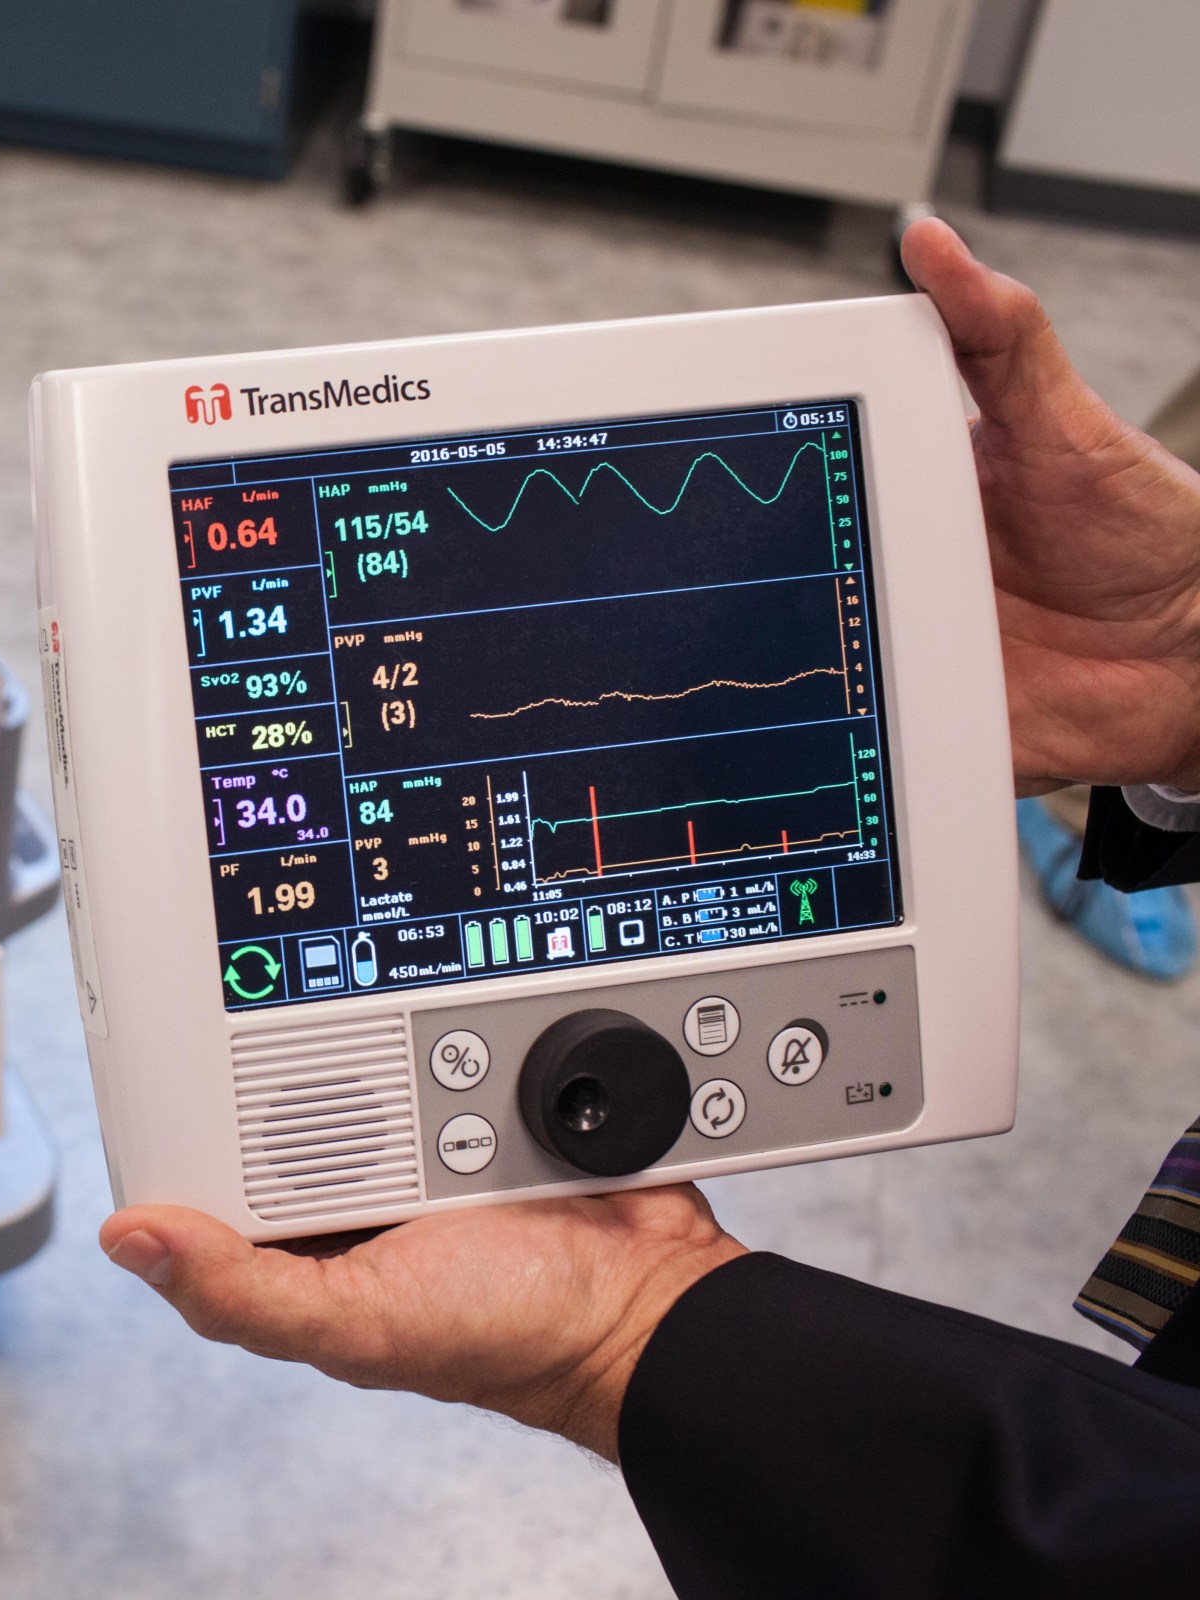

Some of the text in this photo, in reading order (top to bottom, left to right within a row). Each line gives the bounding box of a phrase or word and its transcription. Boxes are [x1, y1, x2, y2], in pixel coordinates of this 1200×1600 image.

[240, 374, 431, 416] TransMedics
[800, 410, 845, 426] 05:15
[410, 432, 608, 463] 2016-05-05 14:34:47
[830, 449, 848, 460] 100
[834, 471, 847, 482] 75
[319, 480, 407, 498] HAP mmHg
[181, 489, 279, 512] HAF L/min
[836, 494, 849, 505] 50
[334, 510, 428, 542] 115/54
[838, 517, 851, 527] 25
[207, 517, 278, 551] 0.64
[843, 539, 850, 549] 0
[357, 549, 408, 582] (84)
[191, 578, 289, 600] PVF L/min
[846, 595, 858, 605] 16
[218, 605, 287, 640] 1.34
[848, 617, 861, 627] 12
[334, 630, 423, 649] PVP mmHg
[853, 640, 860, 650] 8
[855, 662, 862, 672] 4
[372, 662, 419, 690] 4/2
[200, 670, 307, 699] SvO2 93%
[857, 684, 864, 694] 0
[381, 700, 416, 732] (3)
[205, 721, 313, 750] HCT 28%
[857, 748, 876, 759] 120
[211, 773, 256, 790] Temp
[349, 775, 442, 794] HAP mmHg
[862, 772, 875, 782] 90
[461, 796, 476, 807] 20
[496, 791, 519, 804] 1.99
[863, 793, 877, 803] 60
[236, 794, 307, 828] 34.0
[359, 799, 394, 825] 84
[464, 819, 478, 830] 15
[498, 814, 521, 827] 1.61
[865, 816, 879, 826] 30
[297, 827, 329, 841] 34.0
[354, 832, 447, 851] PVP mmHg
[871, 837, 878, 847] 0
[467, 841, 480, 852] 10
[500, 837, 523, 849] 1.22
[847, 850, 876, 862] 14:33
[219, 853, 317, 877] PF L/min
[372, 858, 389, 881] 3
[472, 864, 479, 875] 5
[501, 859, 526, 871] 0.84
[474, 887, 481, 897] 0
[503, 881, 527, 893] 0.46
[532, 888, 562, 902] 11:05
[662, 881, 774, 906] A. P 1 mL/h
[247, 880, 315, 915] 1.99
[360, 892, 413, 908] Lactate
[362, 907, 410, 922] mmol/L
[607, 898, 653, 916] 08:12
[662, 902, 776, 927] B. B 3 mL/h
[534, 907, 579, 925] 10:02
[397, 925, 445, 942] 06:53
[665, 922, 778, 947] C. T 30 mL/h
